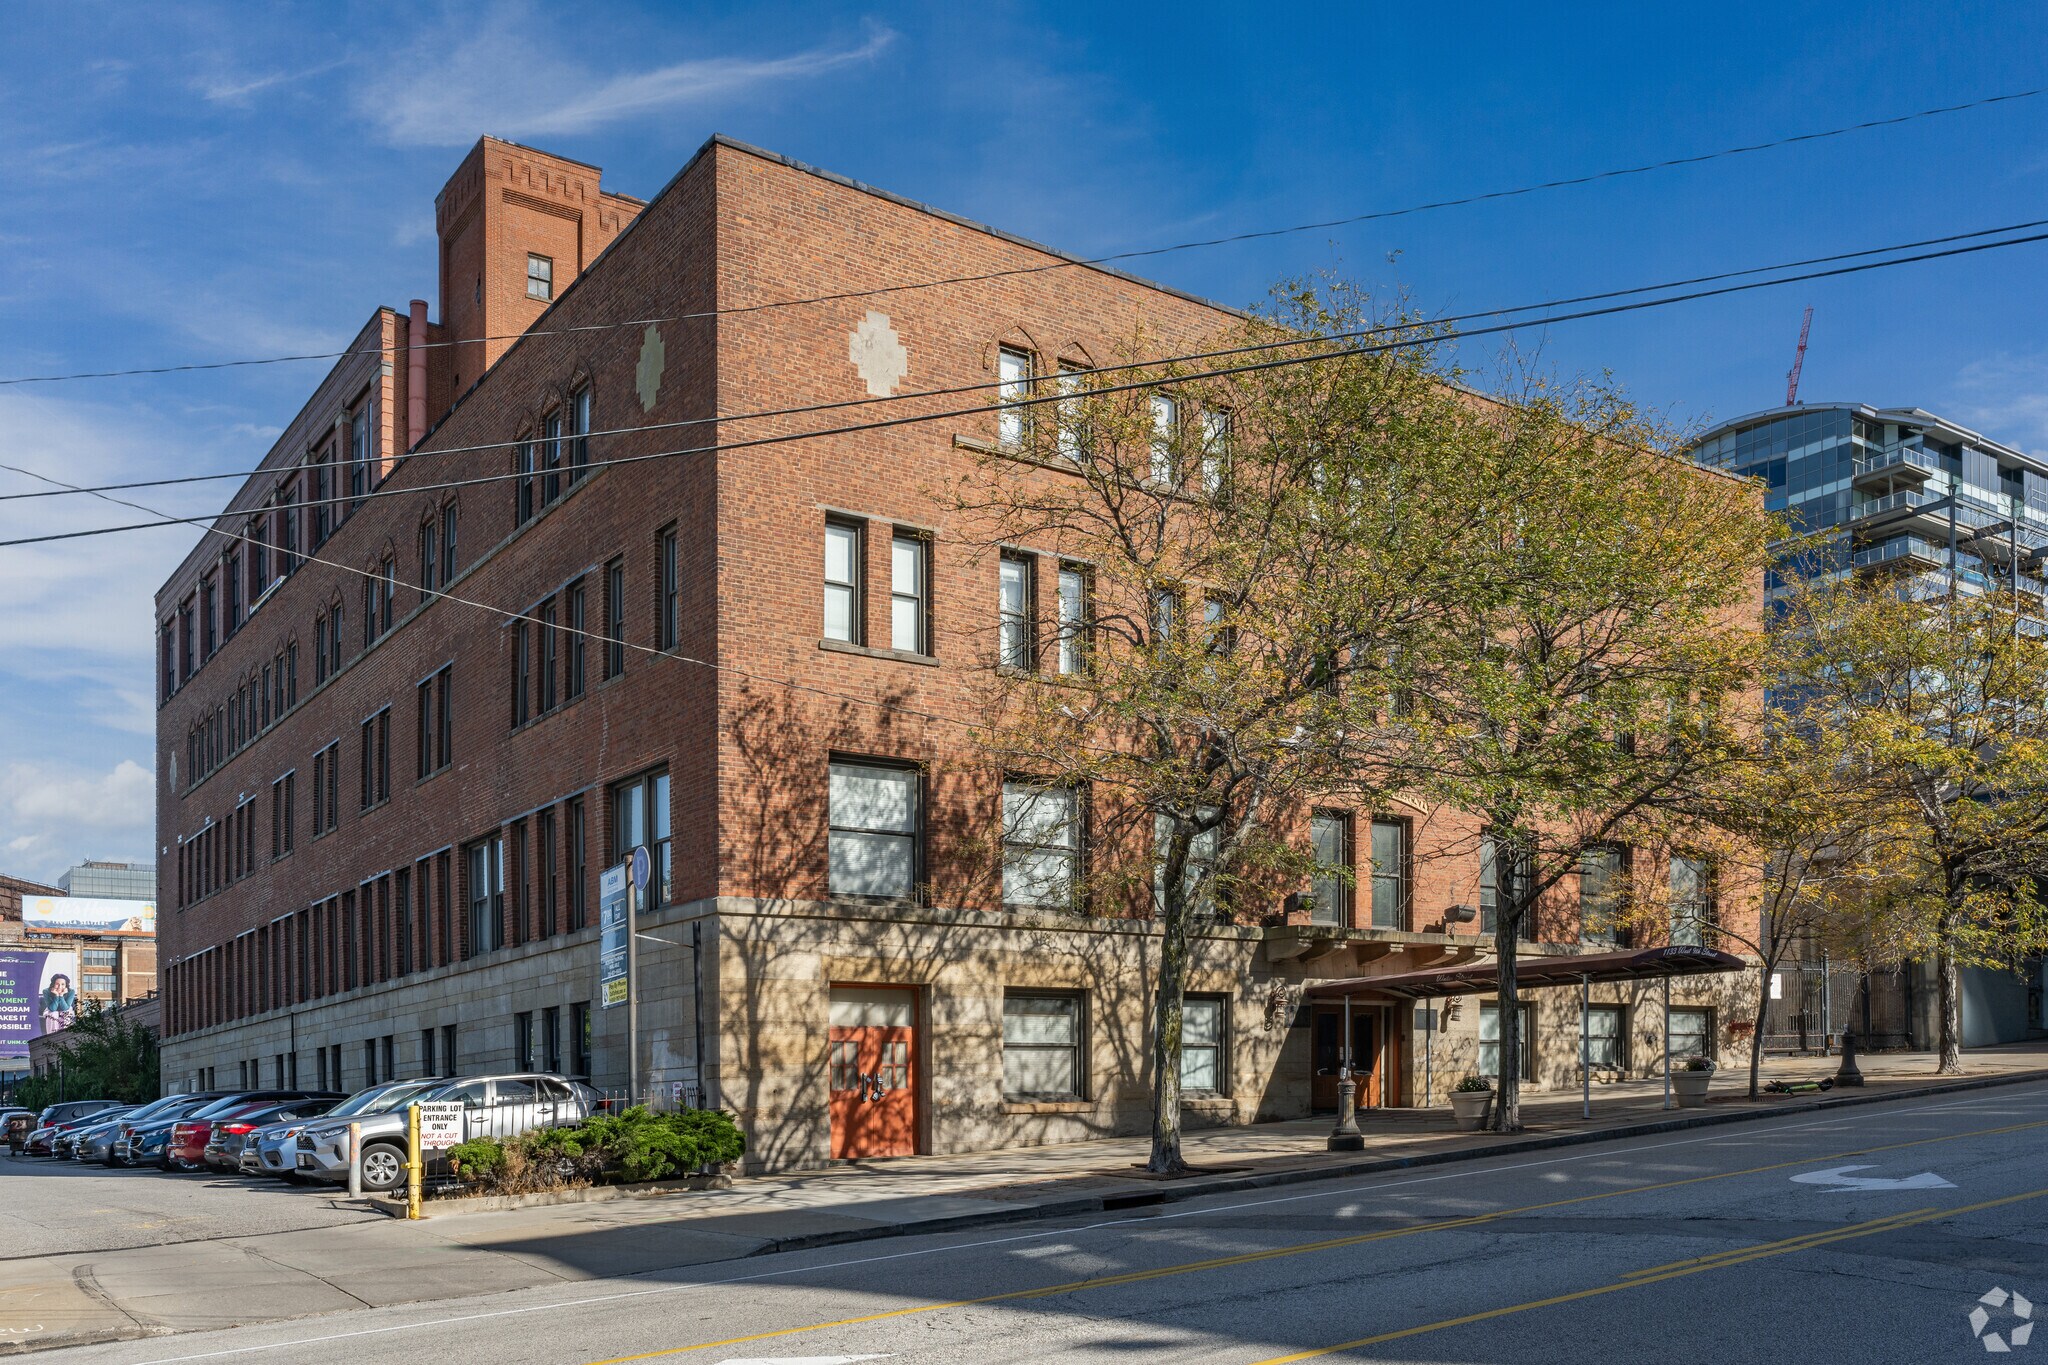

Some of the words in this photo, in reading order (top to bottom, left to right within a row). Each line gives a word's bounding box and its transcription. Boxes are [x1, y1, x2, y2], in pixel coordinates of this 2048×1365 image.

[608, 875, 619, 887] ABM
[1663, 947, 1677, 956] 1133
[1678, 946, 1691, 955] West
[1701, 948, 1718, 958] Street
[1456, 972, 1473, 981] Street
